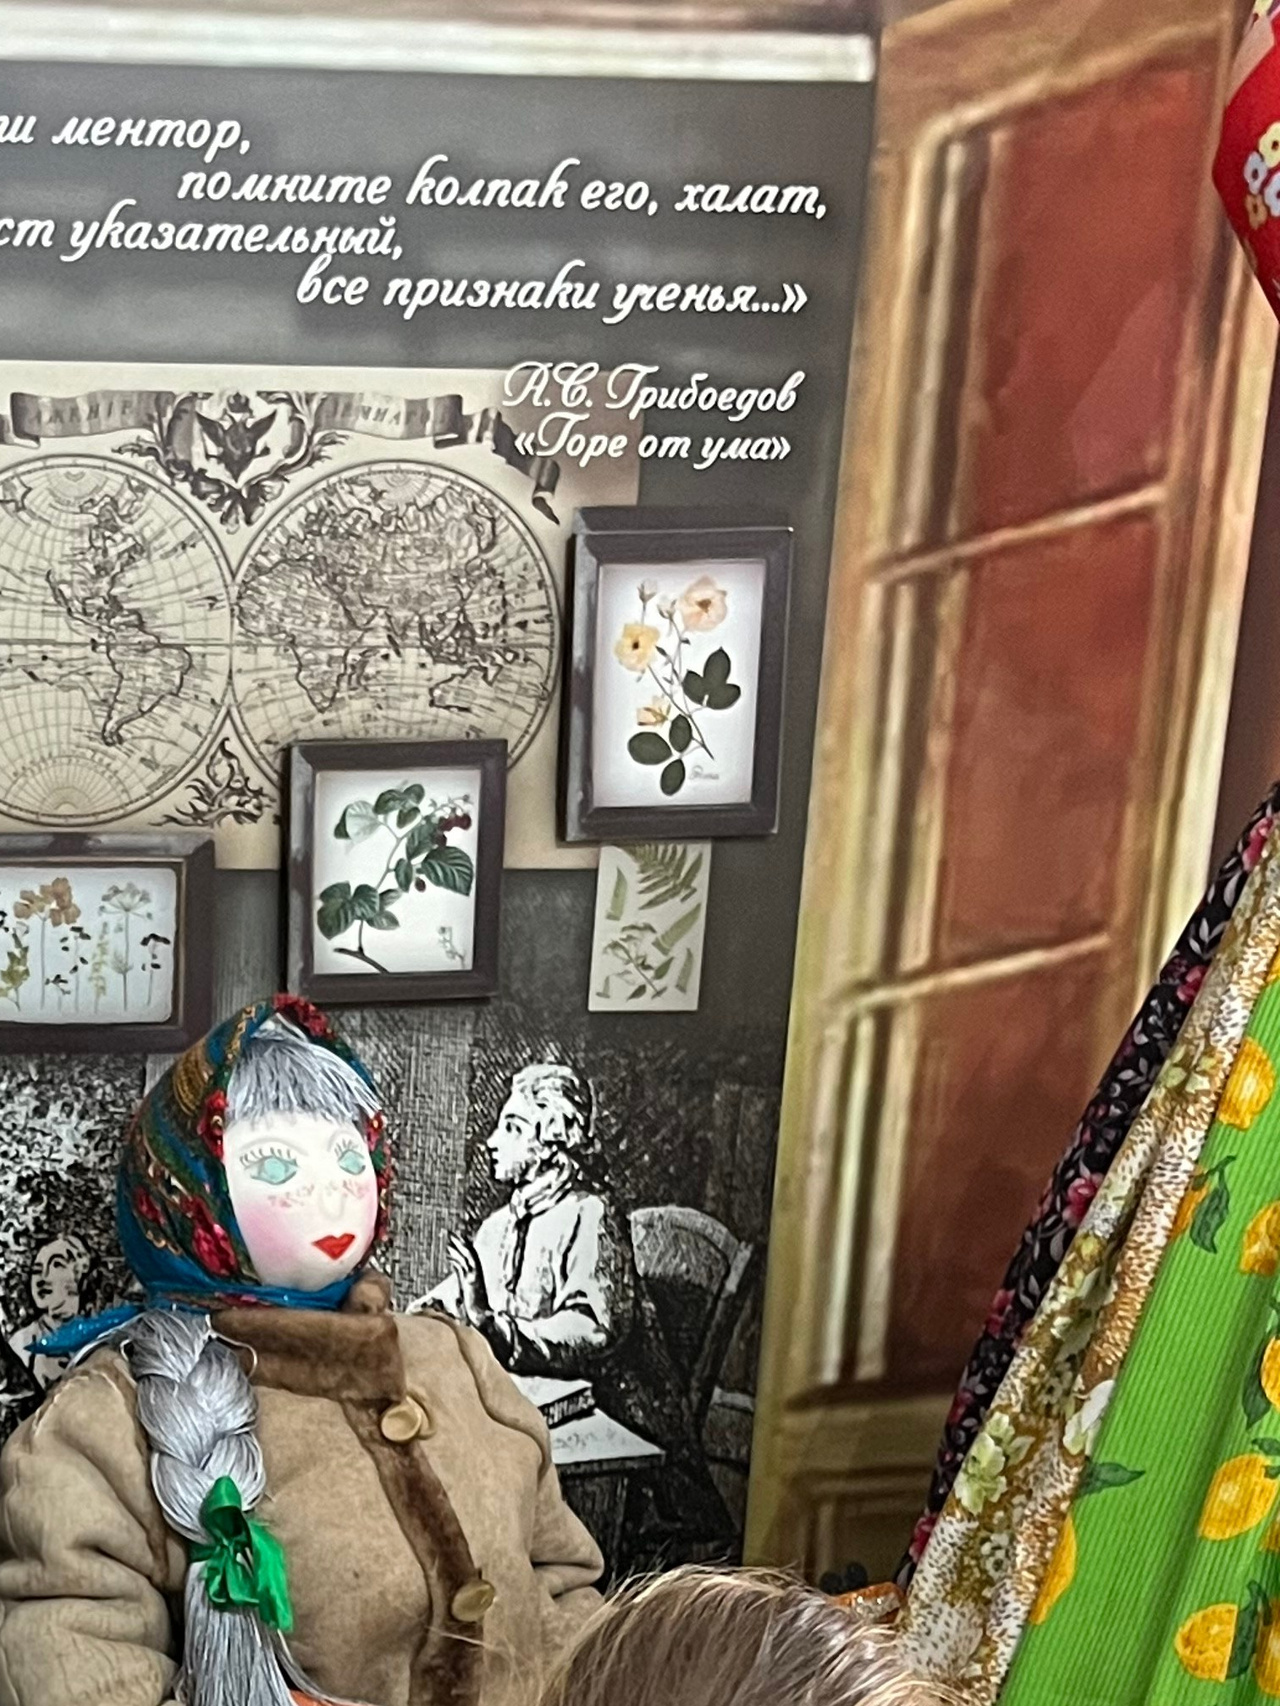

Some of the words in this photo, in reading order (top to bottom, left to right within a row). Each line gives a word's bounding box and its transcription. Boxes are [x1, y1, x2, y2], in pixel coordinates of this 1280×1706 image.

[51, 115, 251, 162] ментор,
[177, 170, 392, 205] помните
[405, 153, 580, 209] колпак
[580, 180, 659, 217] его,
[674, 180, 828, 219] халат,
[60, 199, 404, 262] указательный,
[295, 253, 369, 306] все
[383, 259, 601, 320] признаки
[602, 281, 809, 324] ученья...»
[606, 362, 806, 422] Грибоедов
[514, 411, 625, 468] «Горе
[637, 436, 691, 459] от
[694, 436, 791, 470] ума»
